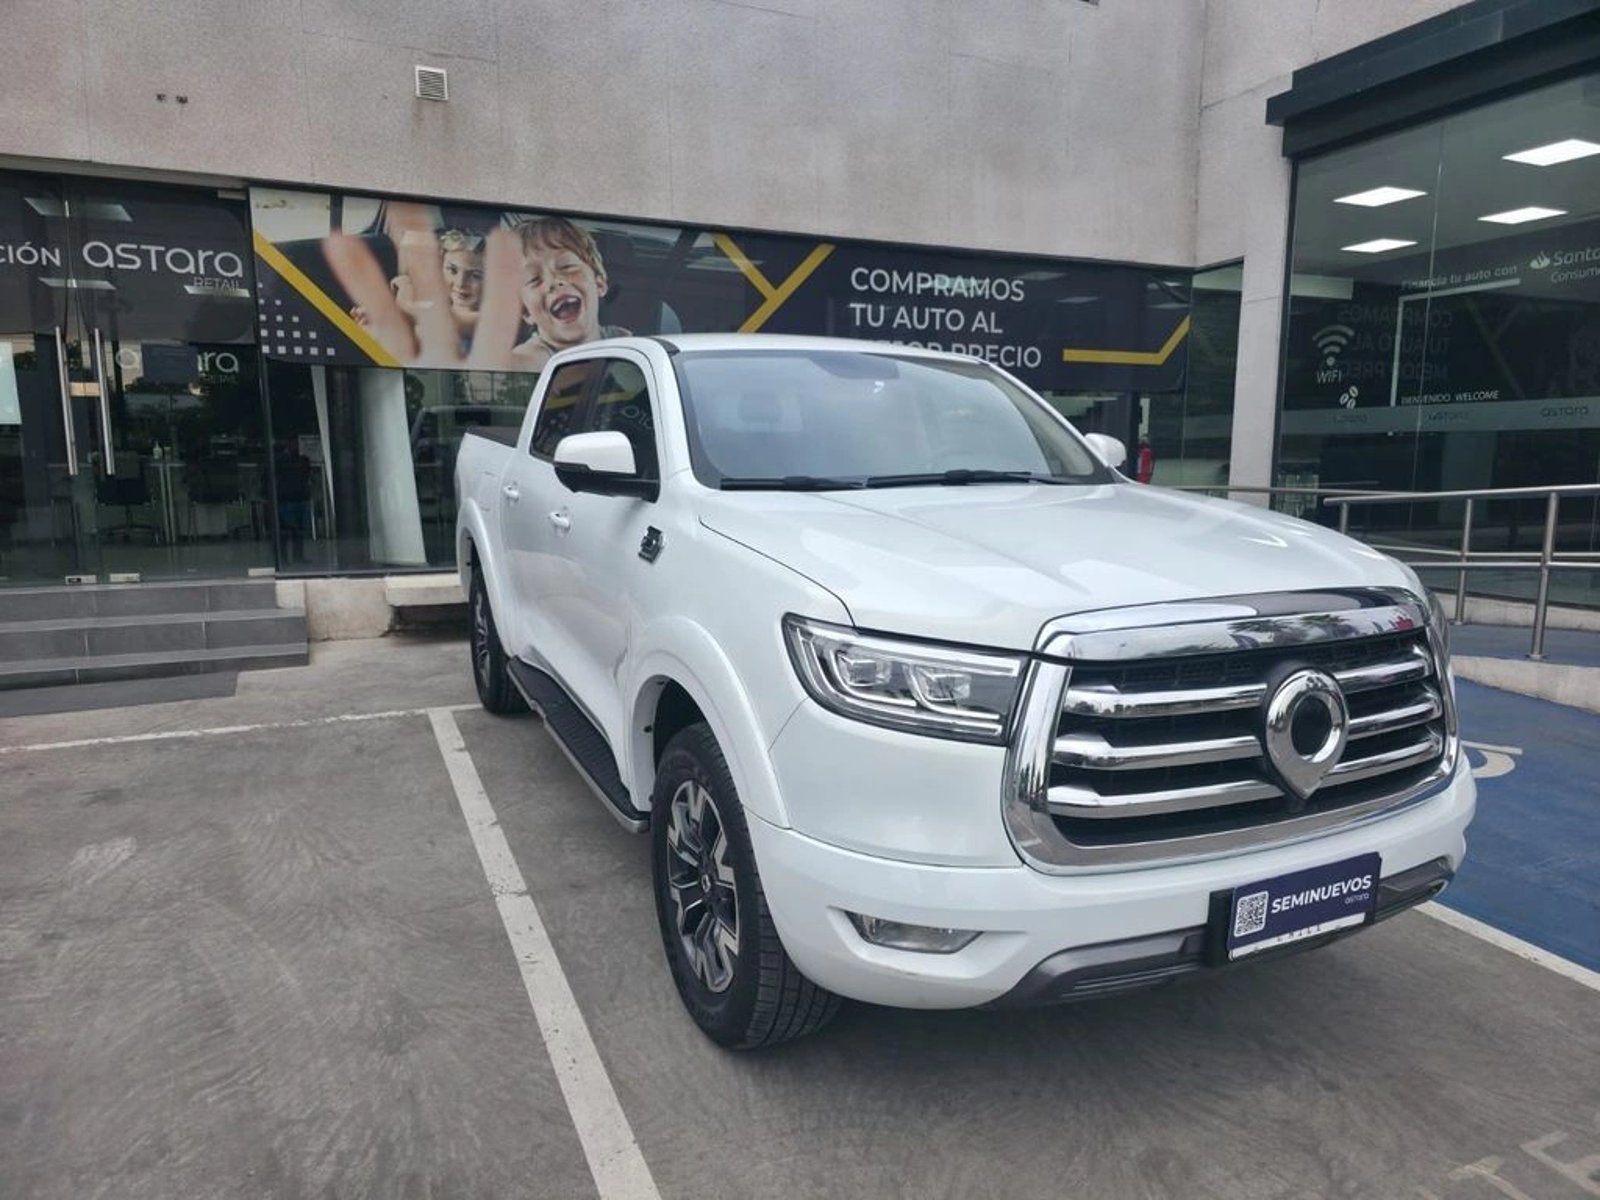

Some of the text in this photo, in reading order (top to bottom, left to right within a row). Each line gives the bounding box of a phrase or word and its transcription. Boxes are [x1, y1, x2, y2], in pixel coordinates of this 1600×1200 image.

[850, 267, 1025, 301] COMPRAMOS
[1494, 265, 1517, 277] con
[849, 303, 1004, 334] TU AUTO AL
[1454, 390, 1500, 401] WELCOME
[1270, 874, 1373, 914] SEMINUEVOS
